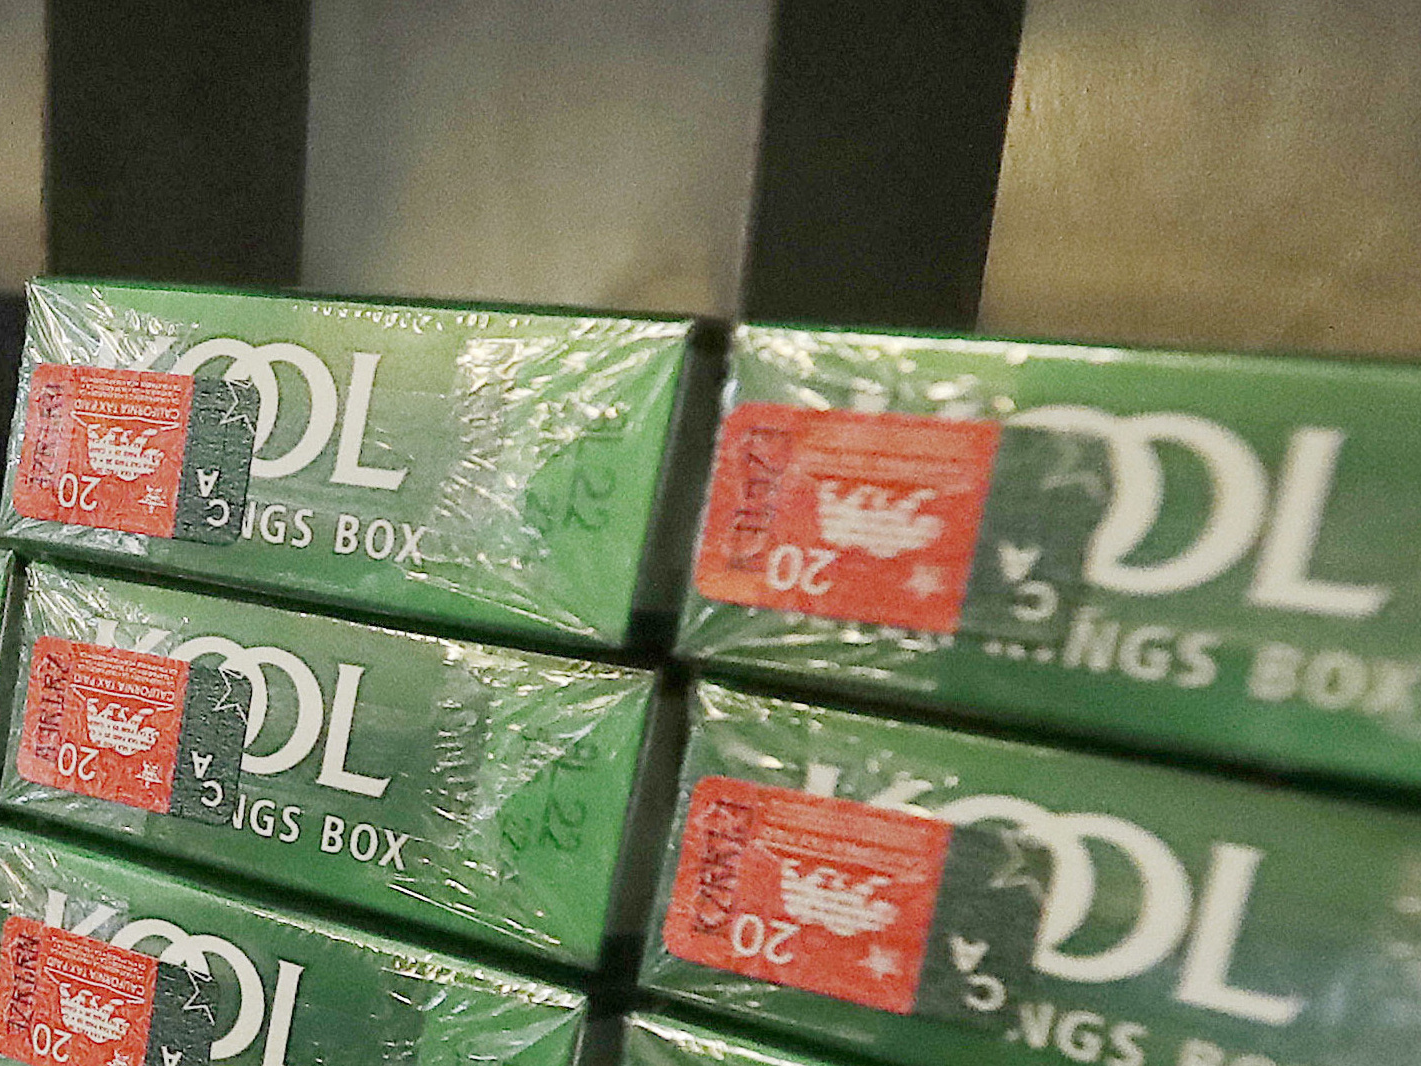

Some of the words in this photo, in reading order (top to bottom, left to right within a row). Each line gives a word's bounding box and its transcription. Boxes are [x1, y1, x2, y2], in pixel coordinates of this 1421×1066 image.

[119, 399, 180, 420] CALIFORNIA
[57, 471, 100, 512] 20
[334, 515, 428, 565] BOX
[767, 543, 838, 596] 20
[119, 680, 176, 701] CALIFORNIA
[1248, 640, 1421, 716] BOX
[57, 742, 100, 781] 20
[320, 814, 409, 871] BOX
[731, 914, 799, 965] 20
[90, 970, 146, 996] CALIFORNIA
[31, 1022, 71, 1062] 20
